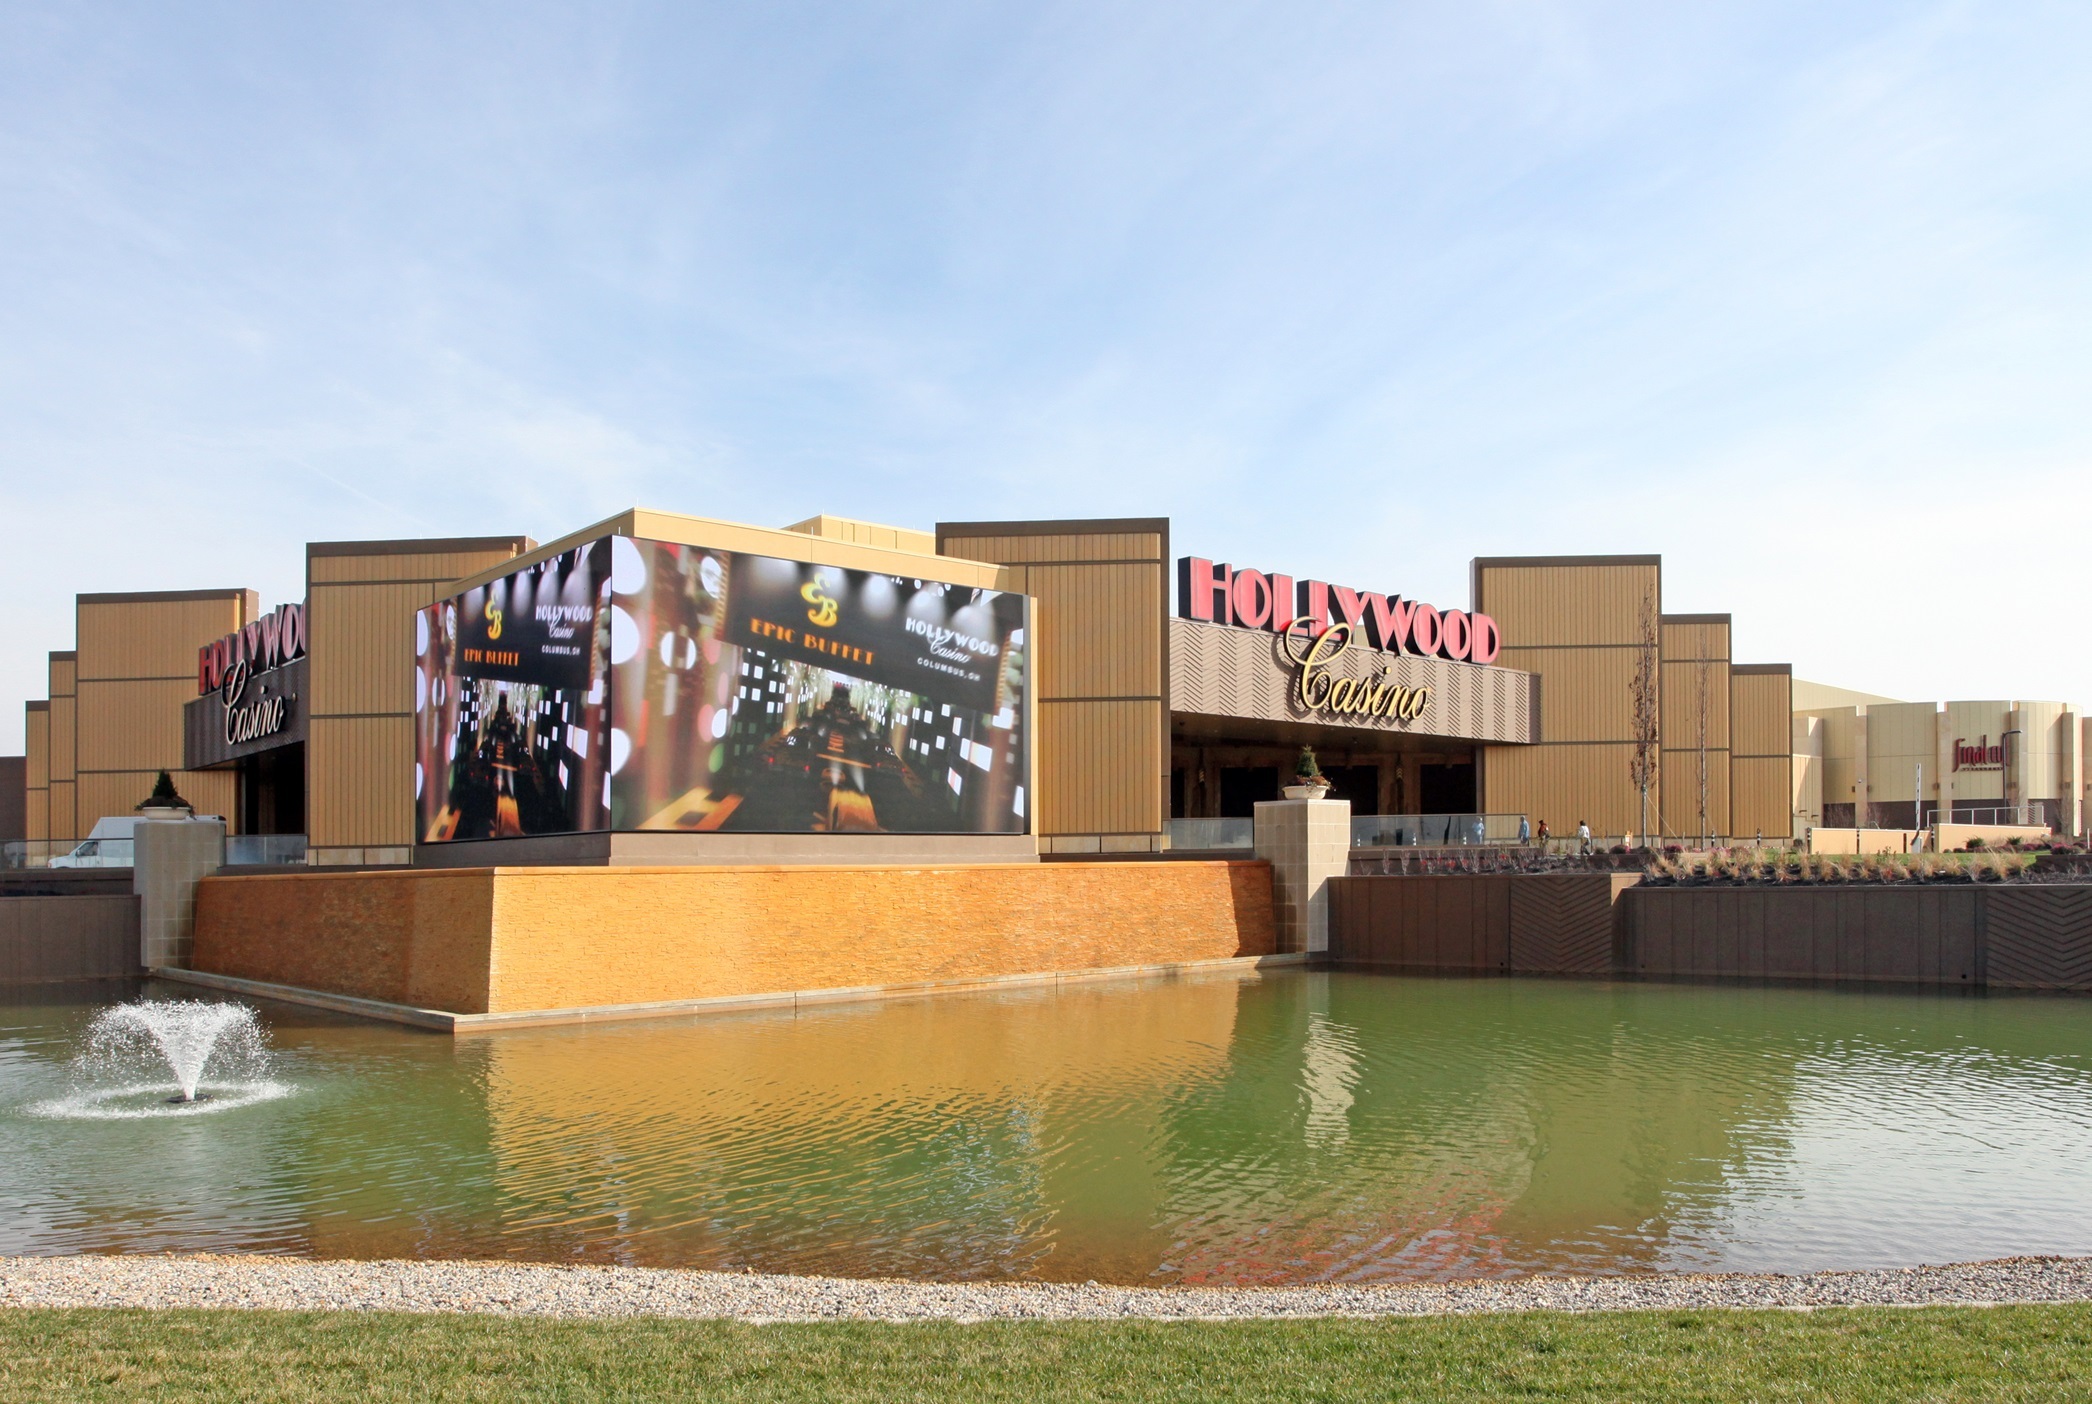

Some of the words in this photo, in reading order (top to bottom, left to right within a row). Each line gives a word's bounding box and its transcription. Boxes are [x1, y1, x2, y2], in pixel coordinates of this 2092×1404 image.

[535, 605, 593, 622] HOLLYWOOD
[548, 612, 575, 638] Casino
[1178, 555, 1501, 664] HOLLYWOOD
[749, 617, 796, 644] EPIC
[804, 633, 874, 666] BUFFET
[905, 617, 1000, 657] HOLLYWOOD
[927, 632, 972, 663] Casino
[464, 649, 482, 662] EPIC
[486, 652, 519, 666] BUFFET
[1284, 616, 1432, 720] Casino
[221, 659, 285, 745] Casino
